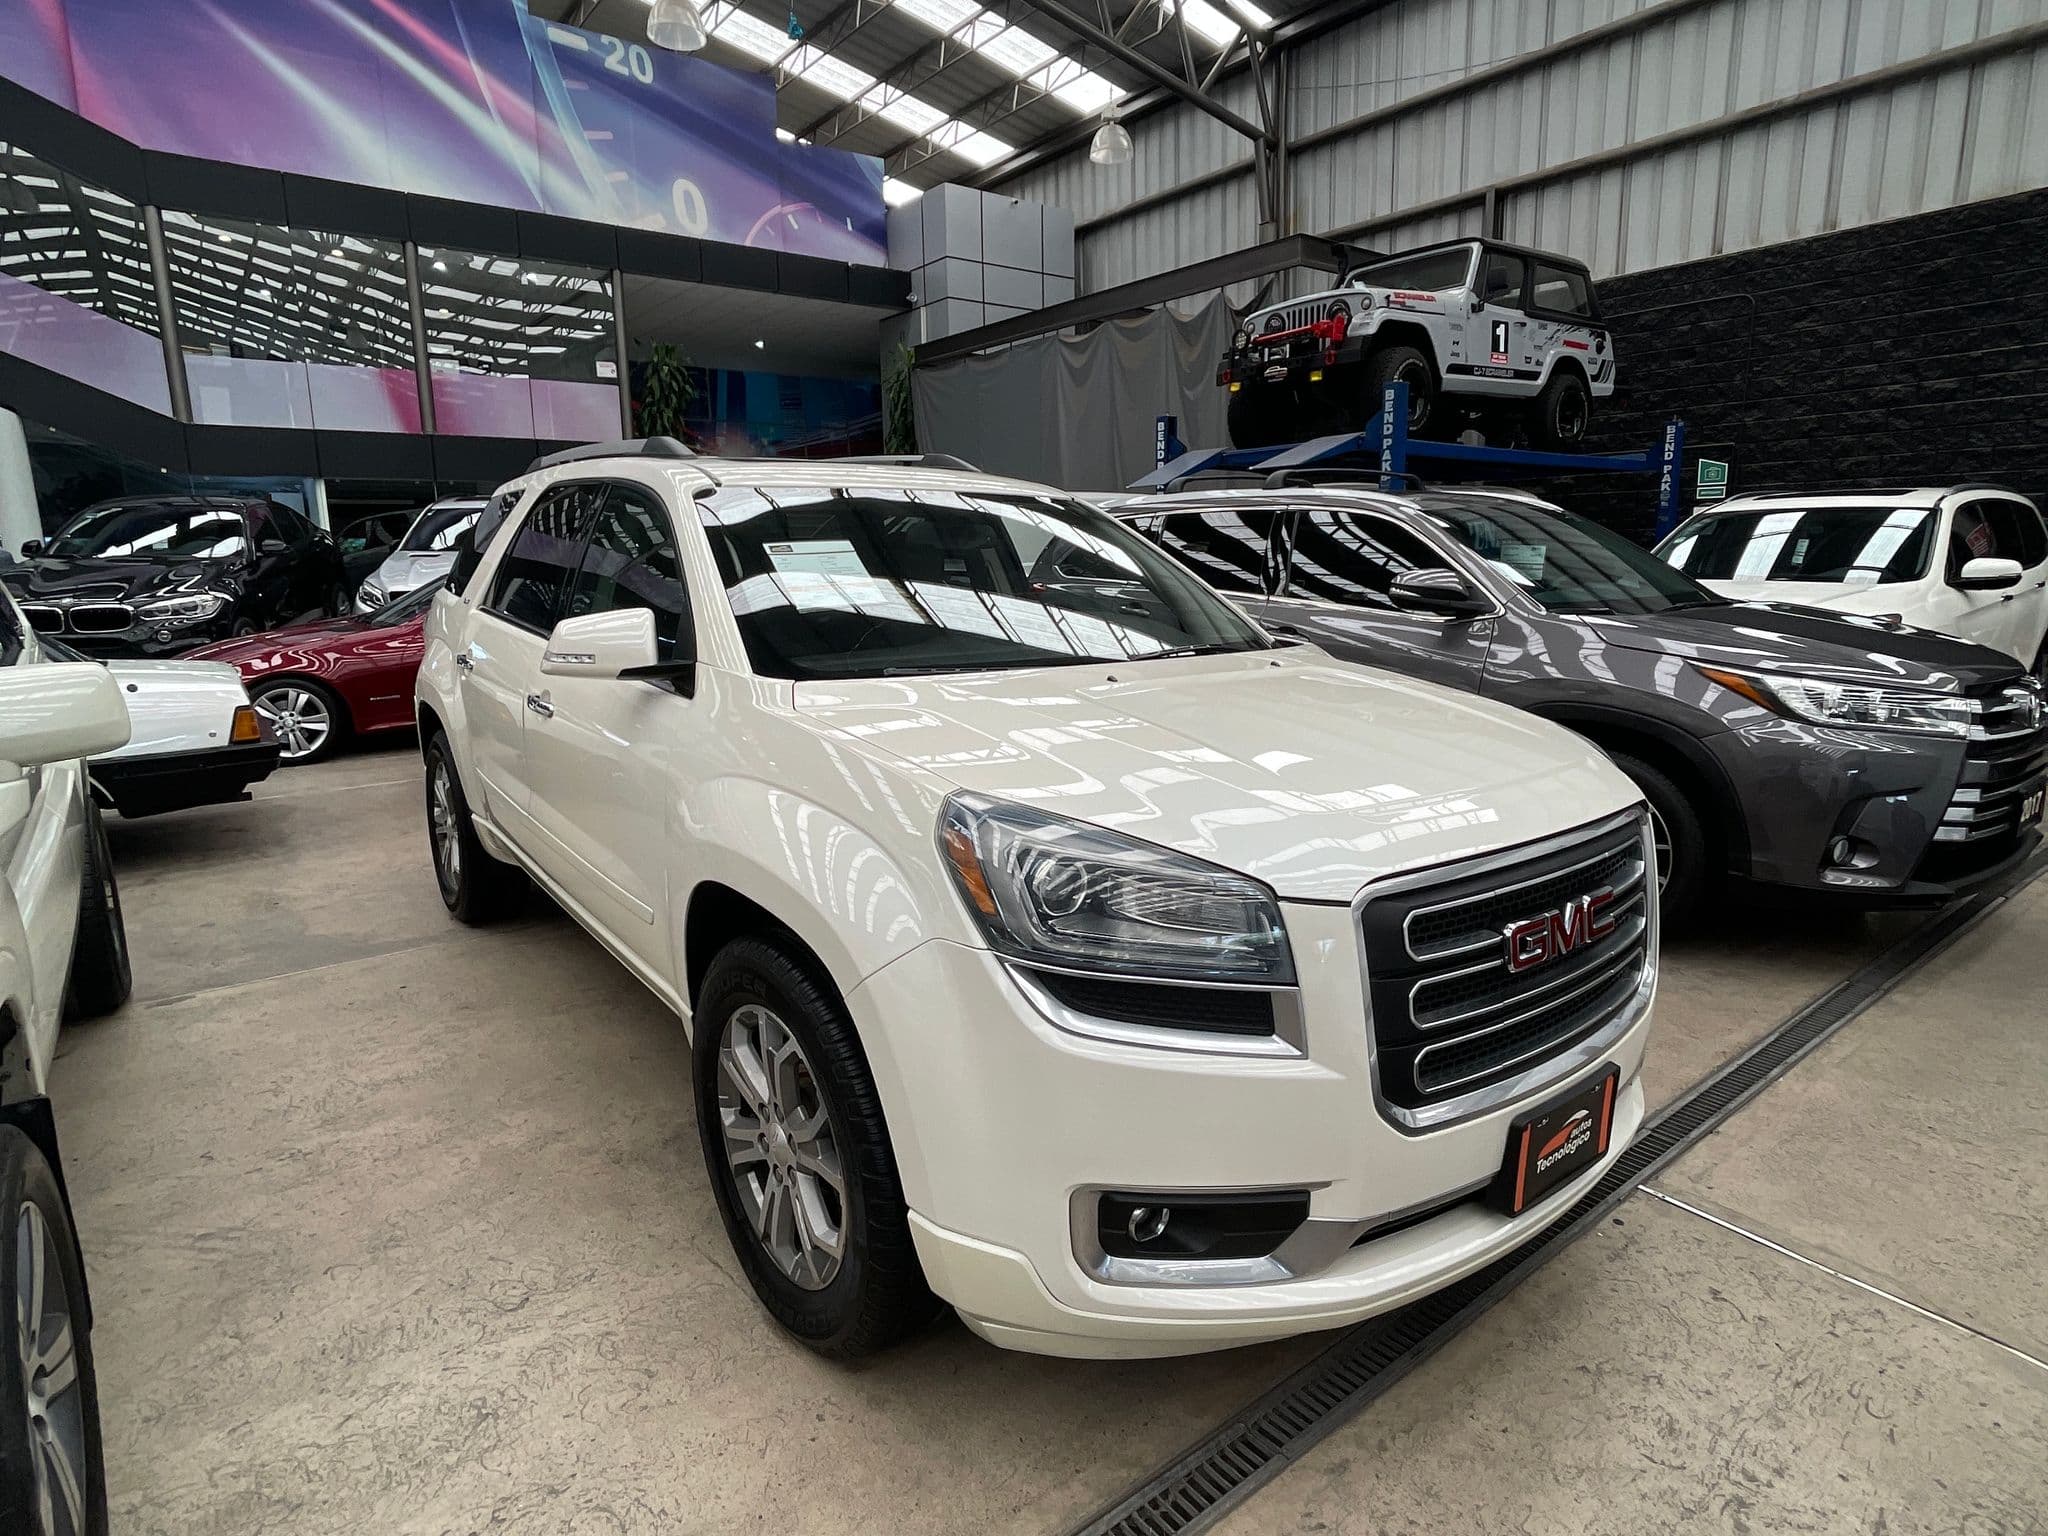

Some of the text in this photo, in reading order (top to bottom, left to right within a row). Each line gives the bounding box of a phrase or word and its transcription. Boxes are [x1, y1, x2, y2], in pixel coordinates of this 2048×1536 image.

[601, 34, 654, 84] 20
[672, 178, 708, 237] 0
[1496, 323, 1505, 352] 1
[1384, 390, 1394, 435] BEND
[1157, 421, 1165, 460] BEND
[1382, 438, 1392, 472] PAK
[1665, 426, 1676, 460] BEND
[1661, 465, 1673, 491] PAK
[1503, 886, 1615, 973] GMC
[1570, 1118, 1593, 1139] autos
[1536, 1130, 1591, 1174] Tecnológico
